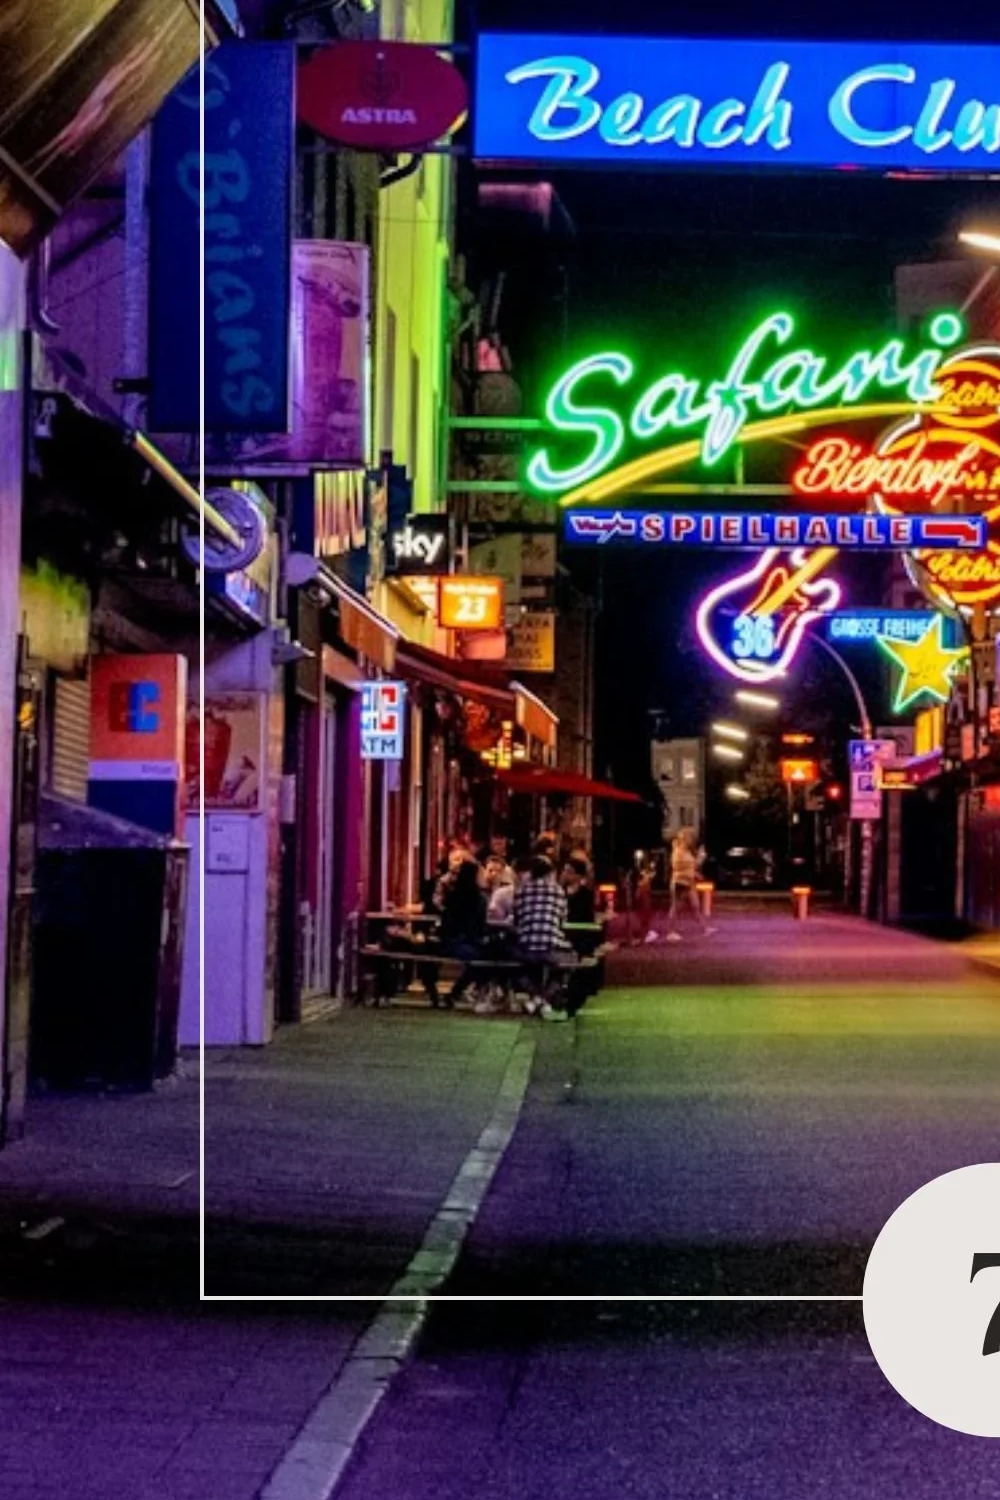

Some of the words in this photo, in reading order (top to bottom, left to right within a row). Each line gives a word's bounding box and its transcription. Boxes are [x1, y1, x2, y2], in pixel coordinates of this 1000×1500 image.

[341, 107, 417, 124] ASTRA
[506, 56, 794, 149] Beach
[527, 311, 964, 493] Safari
[392, 526, 444, 564] sky
[640, 515, 914, 545] SPIELHALLE
[455, 595, 487, 622] 23
[733, 615, 774, 657] 36
